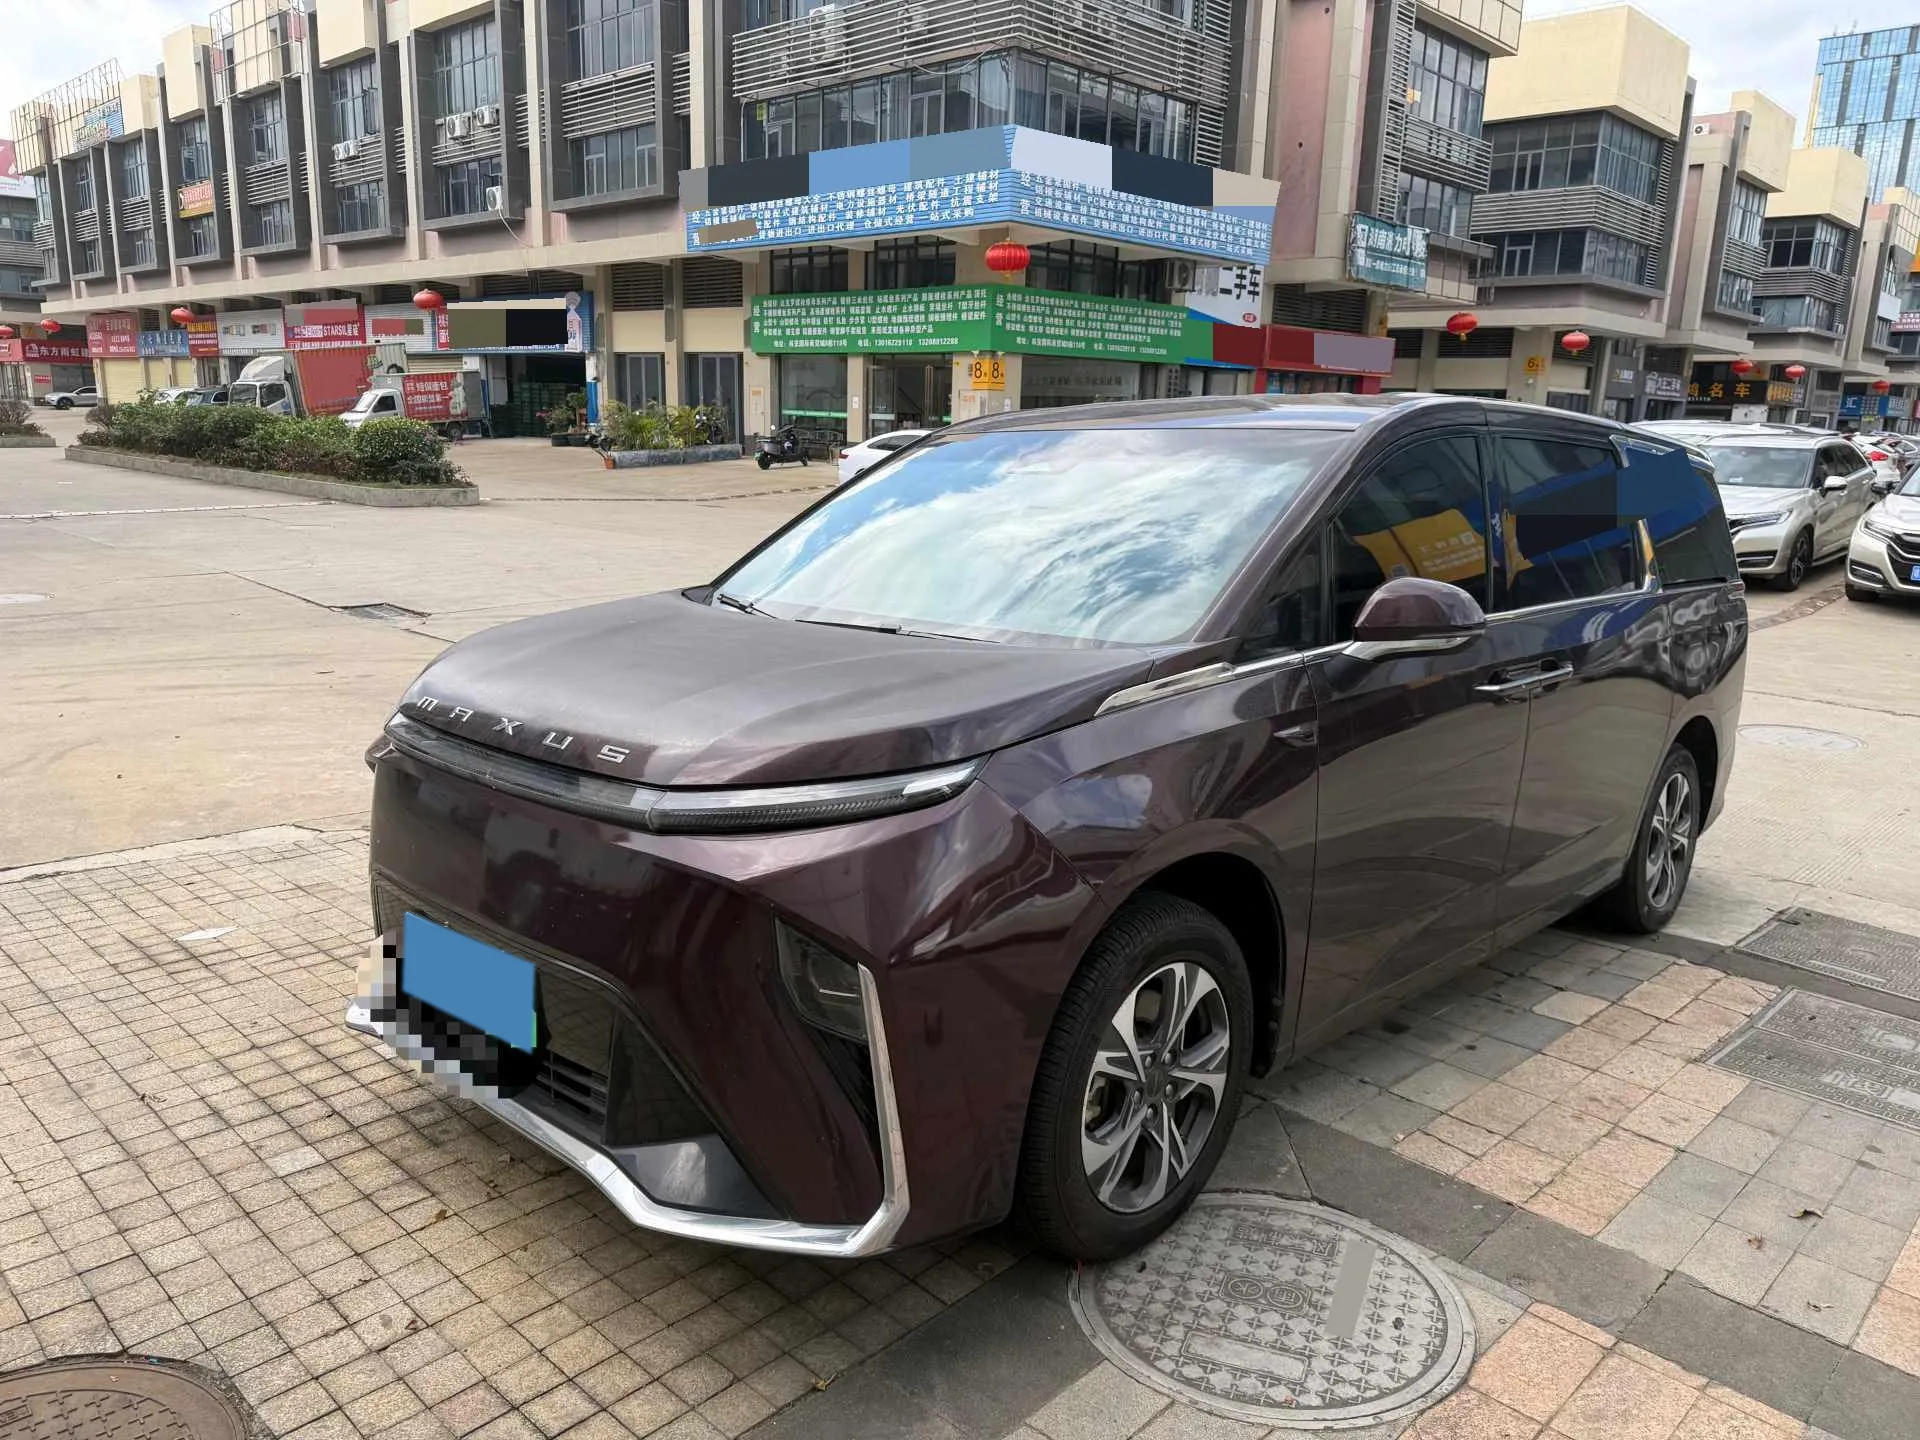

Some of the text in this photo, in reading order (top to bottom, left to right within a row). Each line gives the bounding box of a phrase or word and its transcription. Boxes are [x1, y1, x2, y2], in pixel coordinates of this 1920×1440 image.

[903, 177, 944, 191] 建筑配件
[954, 169, 998, 184] 土建辅材
[906, 180, 998, 202] 桥梁隧道工程辅材
[788, 212, 835, 225] 钢结构配件
[896, 199, 938, 214] 光伏配件
[951, 192, 998, 207] 抗震支架
[1035, 196, 1072, 211] 交通设施
[808, 221, 854, 233] 进出口代理
[919, 206, 974, 222] 一站式采购
[1219, 263, 1261, 303] 二手车
[416, 695, 631, 765] MAXUS
